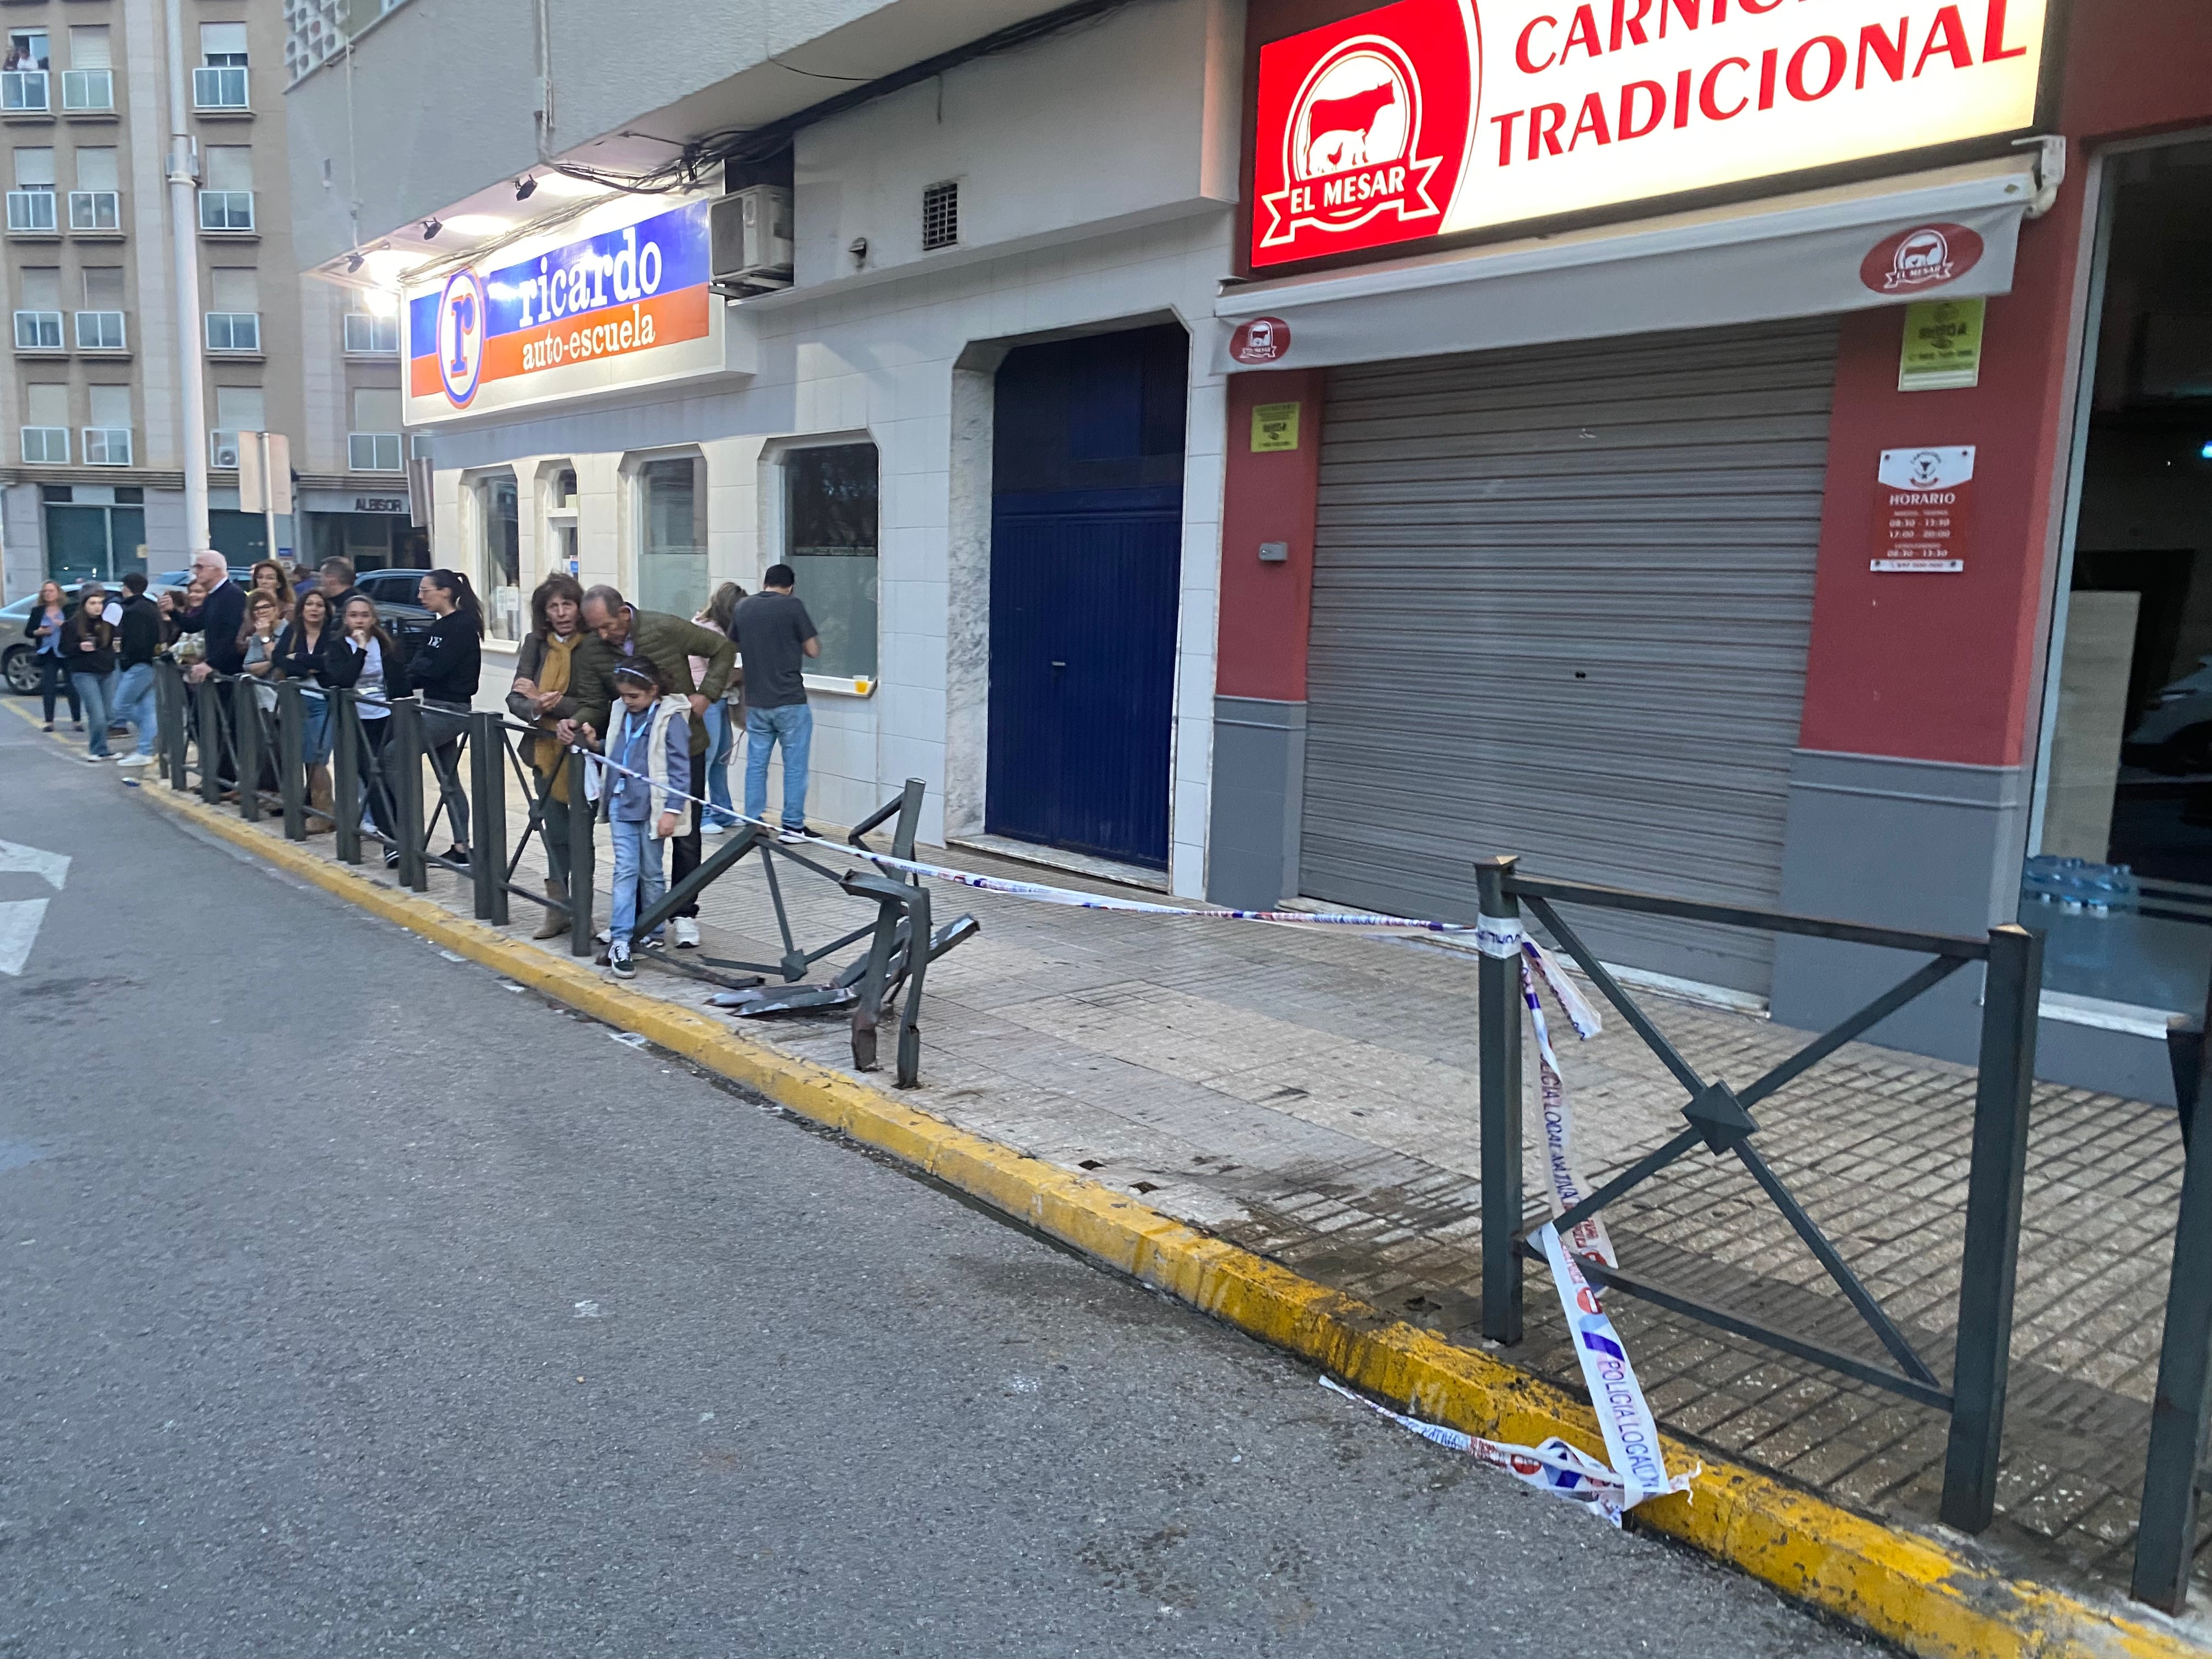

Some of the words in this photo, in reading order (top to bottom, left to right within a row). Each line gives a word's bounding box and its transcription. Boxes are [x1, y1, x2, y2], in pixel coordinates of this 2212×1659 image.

[1490, 0, 2027, 167] TRADICIONAL
[1290, 186, 1316, 215] EL
[1323, 166, 1406, 207] MESAR
[519, 226, 662, 328] ricardo
[522, 303, 656, 371] auto-escuela
[1890, 493, 1955, 505] HORARIO
[1598, 1360, 1635, 1420] POLICIA
[1618, 1423, 1657, 1474] LOCAL
